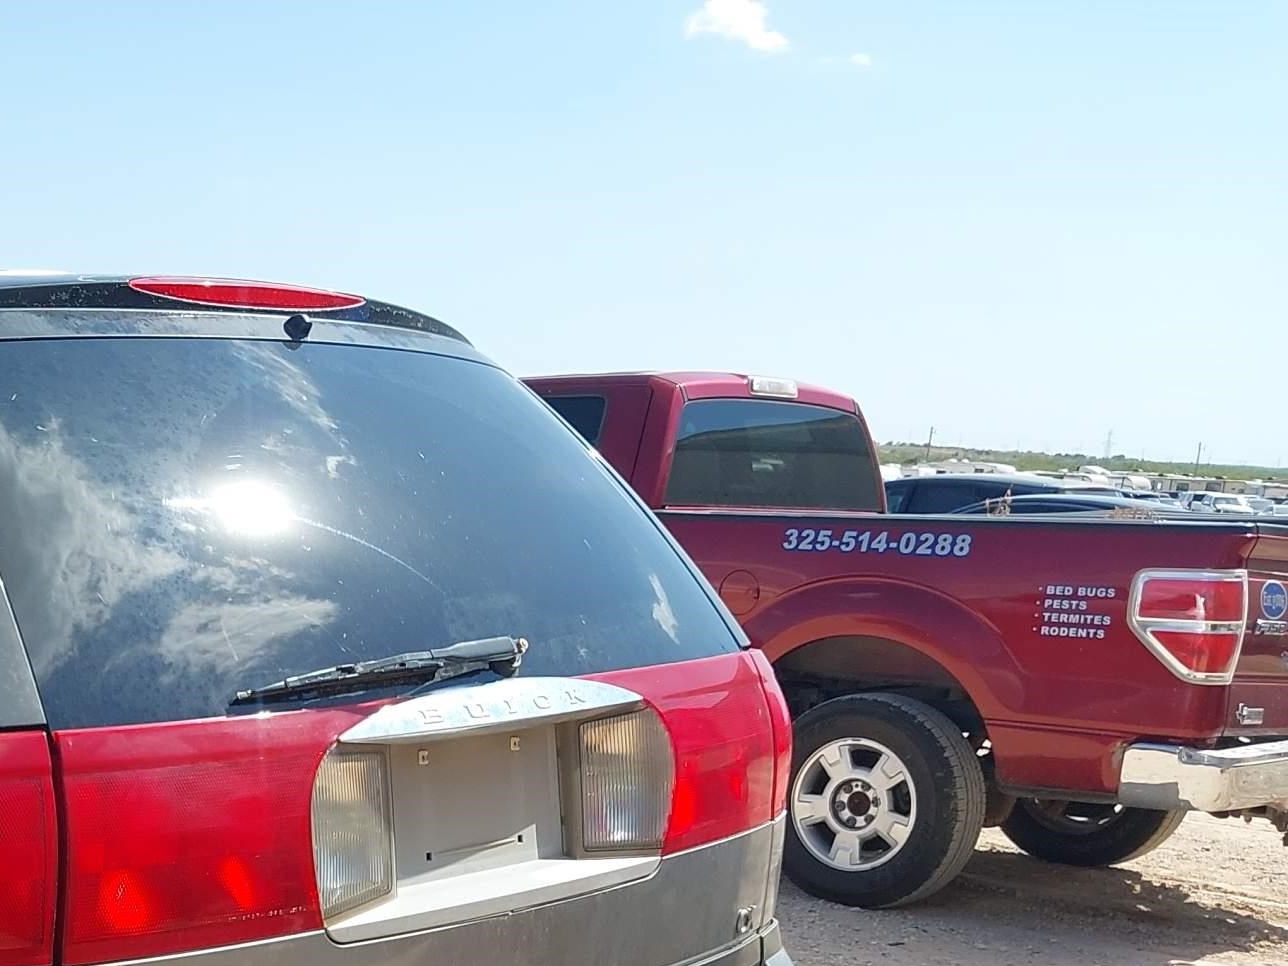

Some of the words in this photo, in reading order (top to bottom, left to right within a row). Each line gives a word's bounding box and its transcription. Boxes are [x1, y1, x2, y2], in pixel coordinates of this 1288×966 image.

[782, 528, 972, 557] 325-514-0288
[1046, 585, 1073, 596] BED
[1077, 586, 1116, 598] BUGS
[1043, 598, 1088, 610] PESTS
[1042, 612, 1112, 626] TERMITES
[1040, 626, 1106, 639] RODENTS
[418, 689, 586, 725] BUICK
